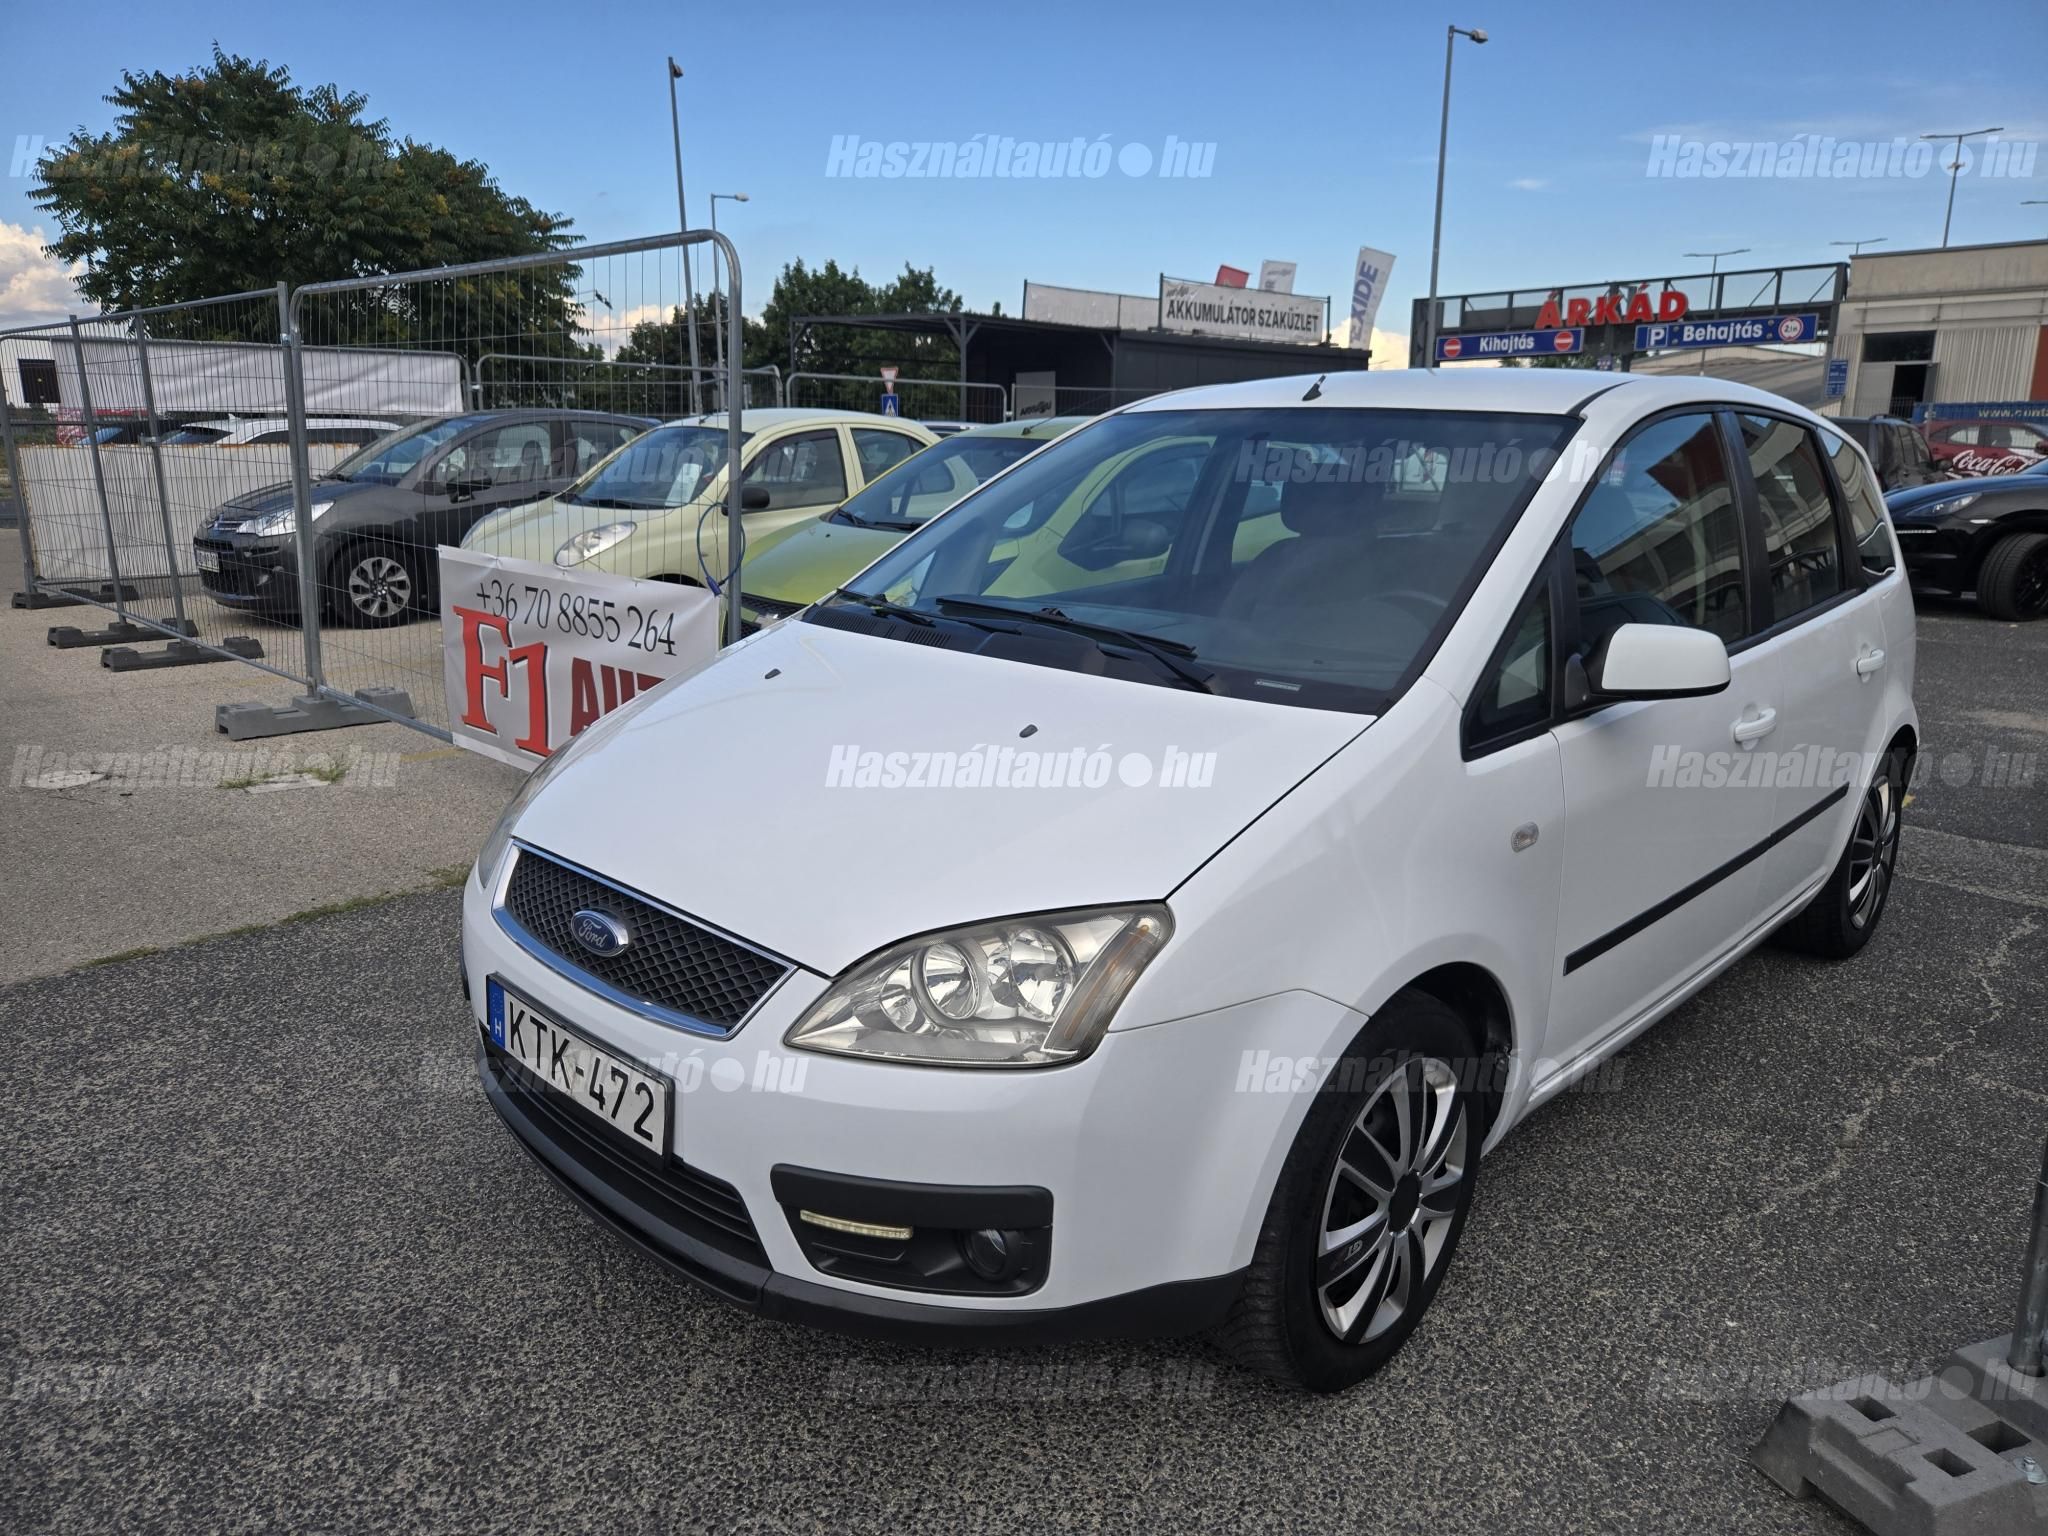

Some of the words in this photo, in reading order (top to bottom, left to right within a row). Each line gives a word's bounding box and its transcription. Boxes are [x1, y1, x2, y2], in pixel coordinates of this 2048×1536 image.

[1167, 298, 1256, 326] AKKUMULÁTOR
[1258, 307, 1319, 333] SZAKÜZLET
[1349, 261, 1378, 343] EXIDE
[1534, 281, 1689, 330] ÁRKÁD
[1479, 334, 1535, 353] Kihajtás
[1650, 328, 1665, 346] P
[1682, 321, 1763, 343] Behajtás
[476, 579, 518, 621] +36
[524, 586, 551, 629] 70
[557, 593, 621, 642] 8855
[627, 606, 678, 656] 264
[453, 605, 556, 758] F1
[578, 918, 608, 948] Ford
[509, 1001, 654, 1142] KTK-472
